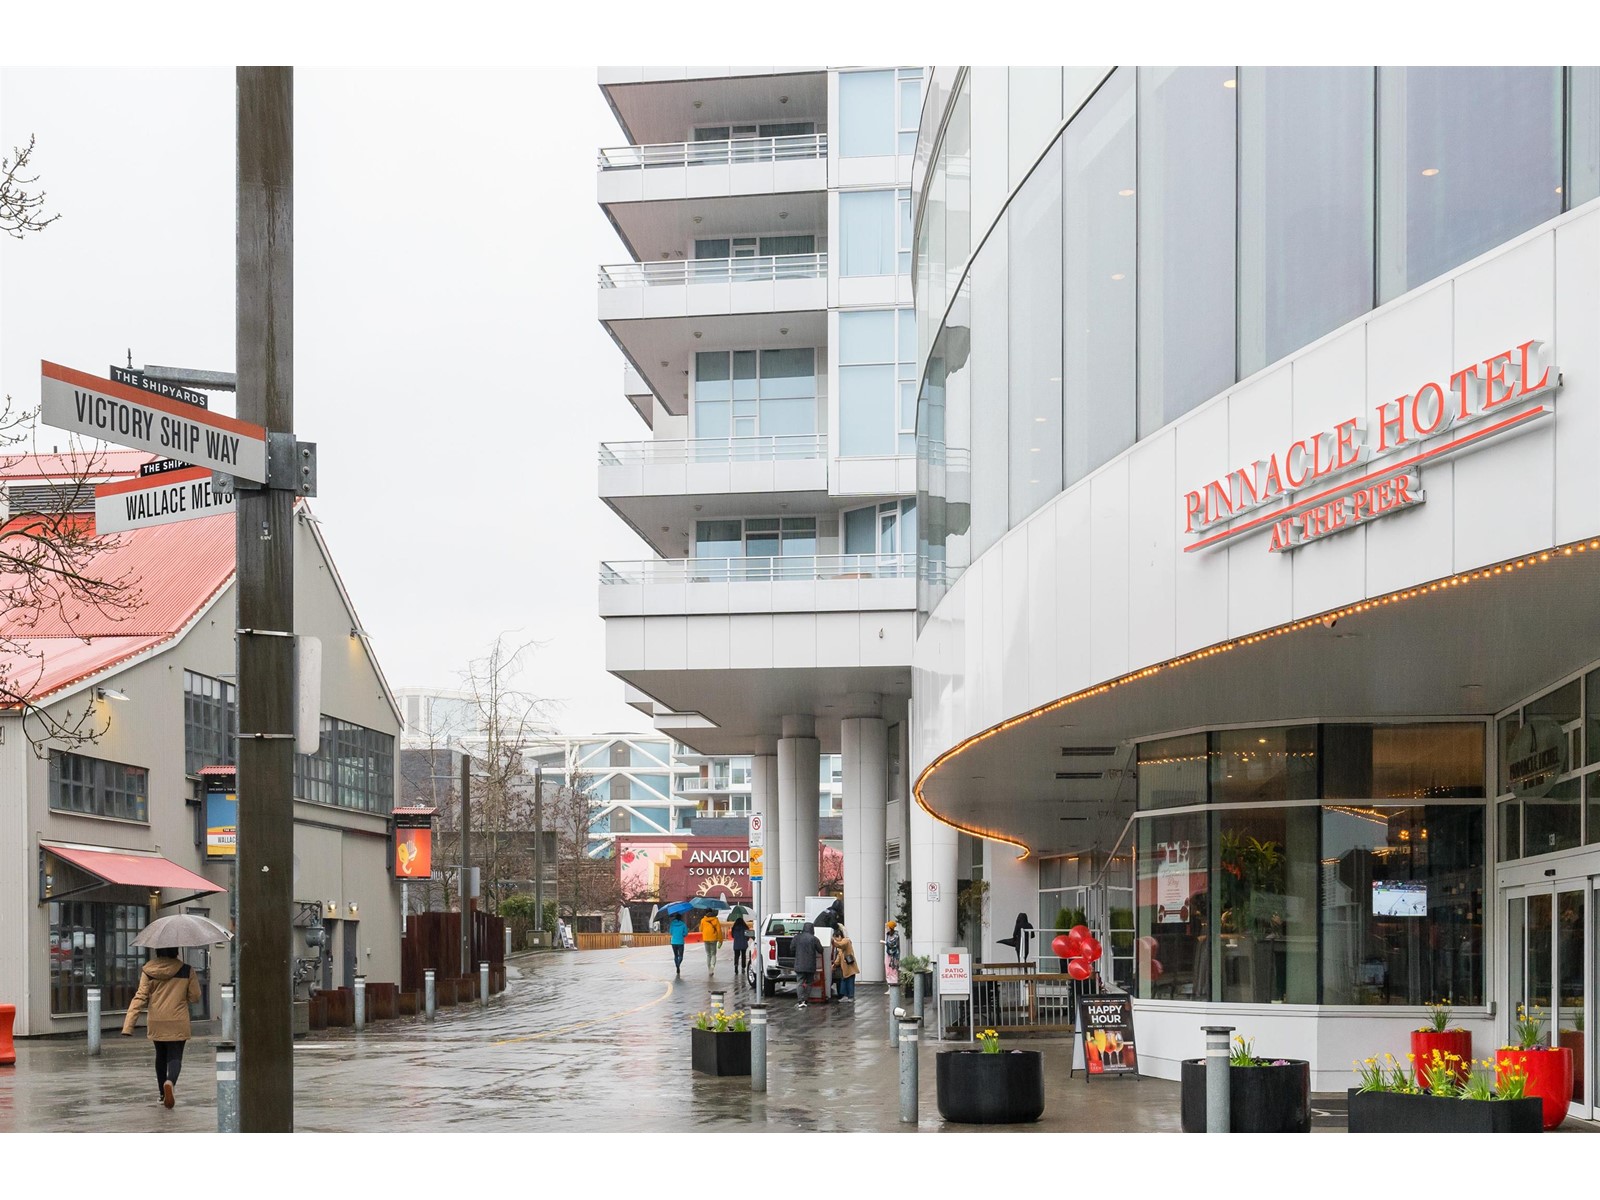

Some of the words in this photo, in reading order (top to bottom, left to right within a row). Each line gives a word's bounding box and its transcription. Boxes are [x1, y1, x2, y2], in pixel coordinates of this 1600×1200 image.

[115, 369, 138, 386] THE
[142, 378, 206, 406] SHIPYARDS
[74, 390, 154, 441] VICTORY
[160, 416, 200, 454] SHIP
[206, 429, 240, 466] WAY
[1184, 417, 1361, 534] PINNACLE
[1375, 339, 1551, 454] HOTEL
[143, 462, 160, 474] THE
[163, 460, 192, 470] SHIP
[125, 486, 186, 521] WALLACE
[1268, 520, 1294, 553] AT
[1300, 500, 1347, 541] THE
[1353, 474, 1414, 523] PIER
[689, 850, 749, 863] ANATOLI
[689, 867, 749, 876] SOUVLAKI
[1088, 1005, 1122, 1015] HAPPY
[1091, 1014, 1122, 1024] HOUR
